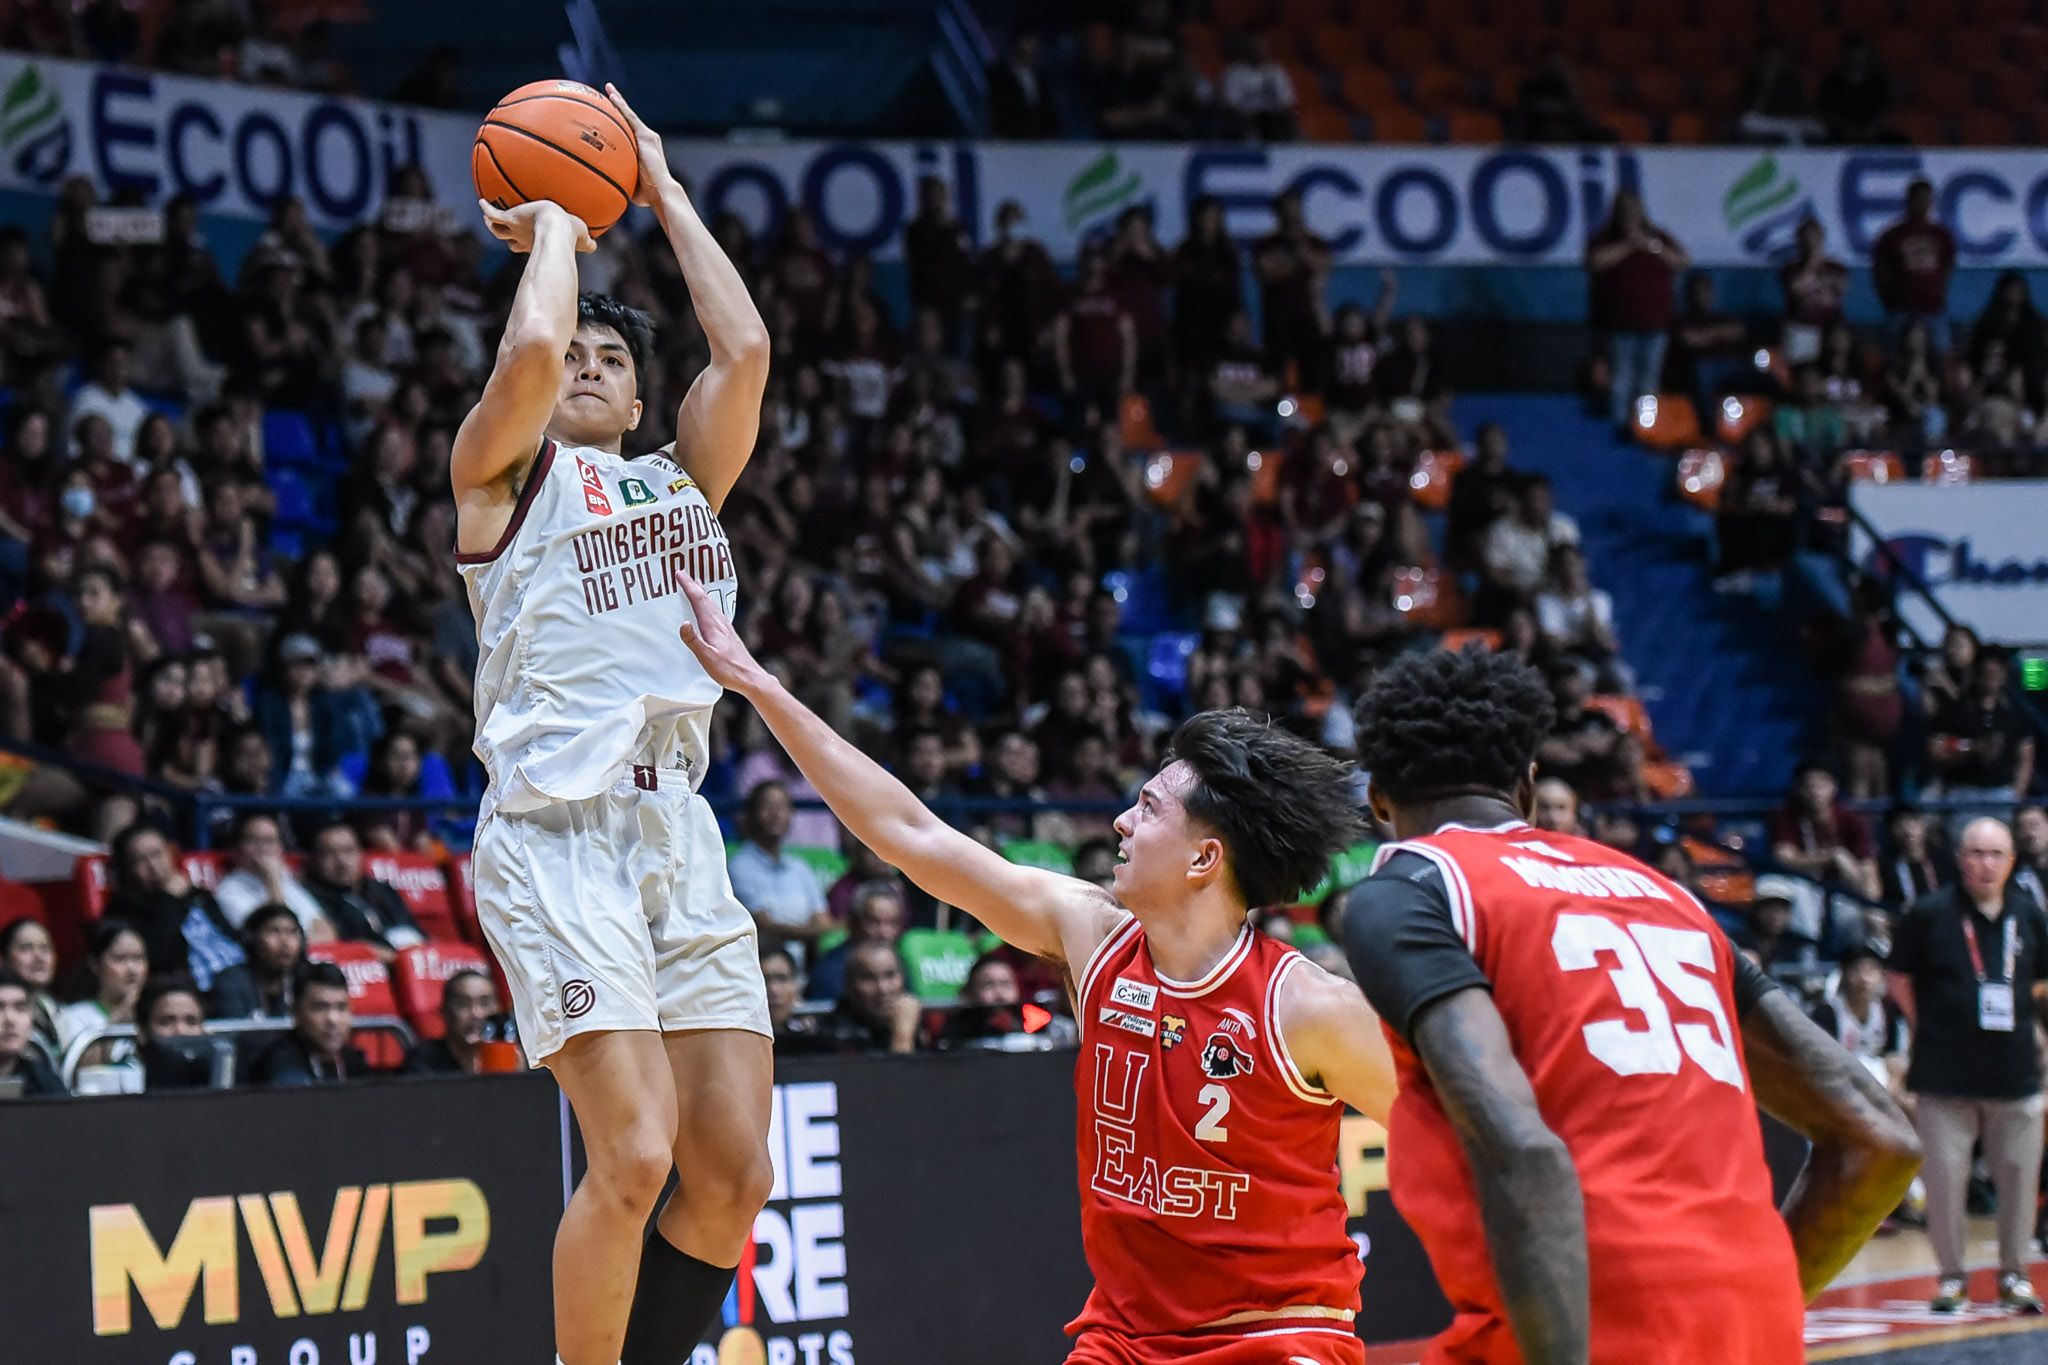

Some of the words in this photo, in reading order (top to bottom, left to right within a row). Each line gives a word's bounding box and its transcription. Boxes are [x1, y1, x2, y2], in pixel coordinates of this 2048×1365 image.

[573, 504, 727, 574] UNIBERSIDA
[582, 572, 619, 616] NG
[1117, 987, 1148, 1003] C-vitt
[1216, 1018, 1242, 1035] ANTA
[1551, 912, 1746, 1094] 35
[1094, 1043, 1150, 1125] U
[1195, 1083, 1231, 1142] 2
[1091, 1119, 1250, 1221] EAST
[89, 1178, 492, 1336] MVP
